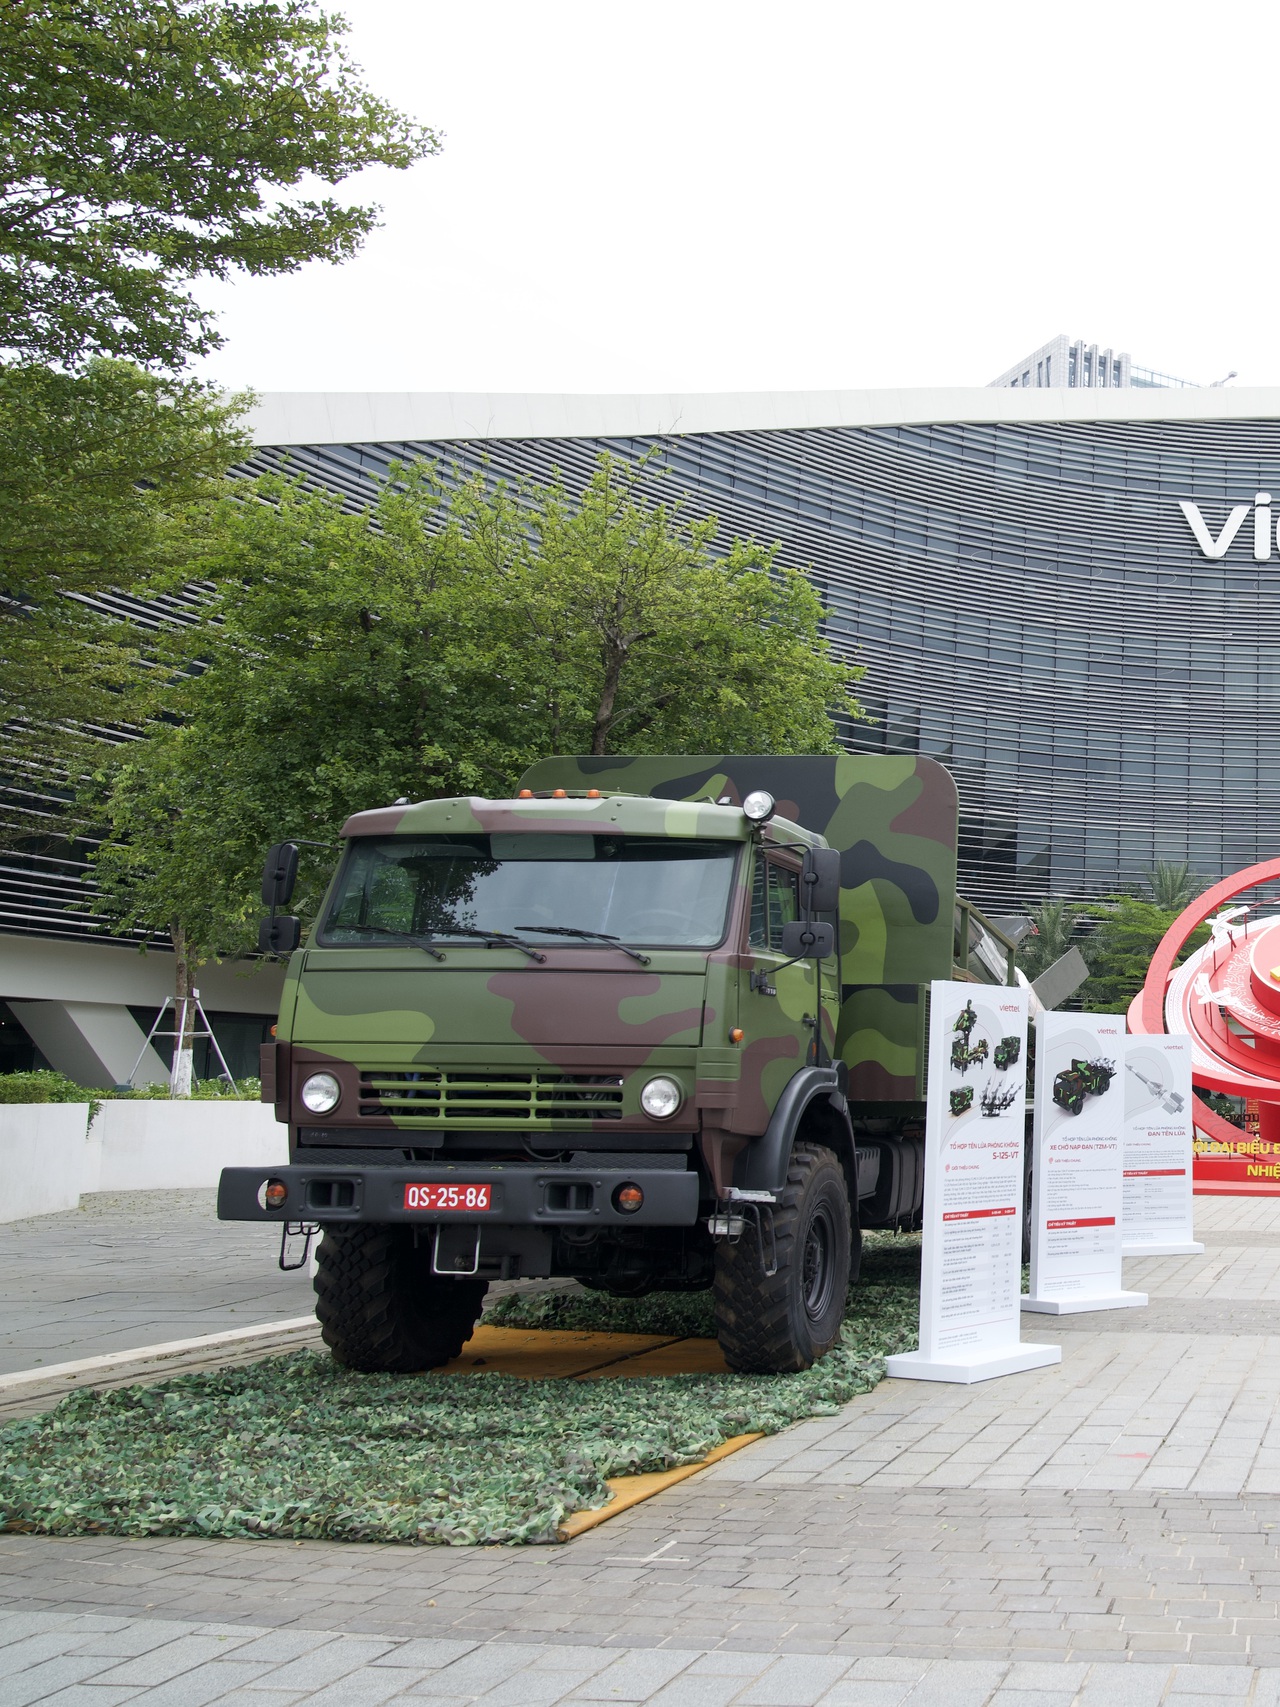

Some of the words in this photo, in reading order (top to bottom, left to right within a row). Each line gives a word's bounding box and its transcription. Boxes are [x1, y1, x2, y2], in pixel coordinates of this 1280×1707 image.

[993, 1151, 1019, 1159] S-125-VT
[1193, 1138, 1208, 1155] ỘI
[1236, 1137, 1270, 1154] BIỂU
[408, 1187, 487, 1207] QS-25-86
